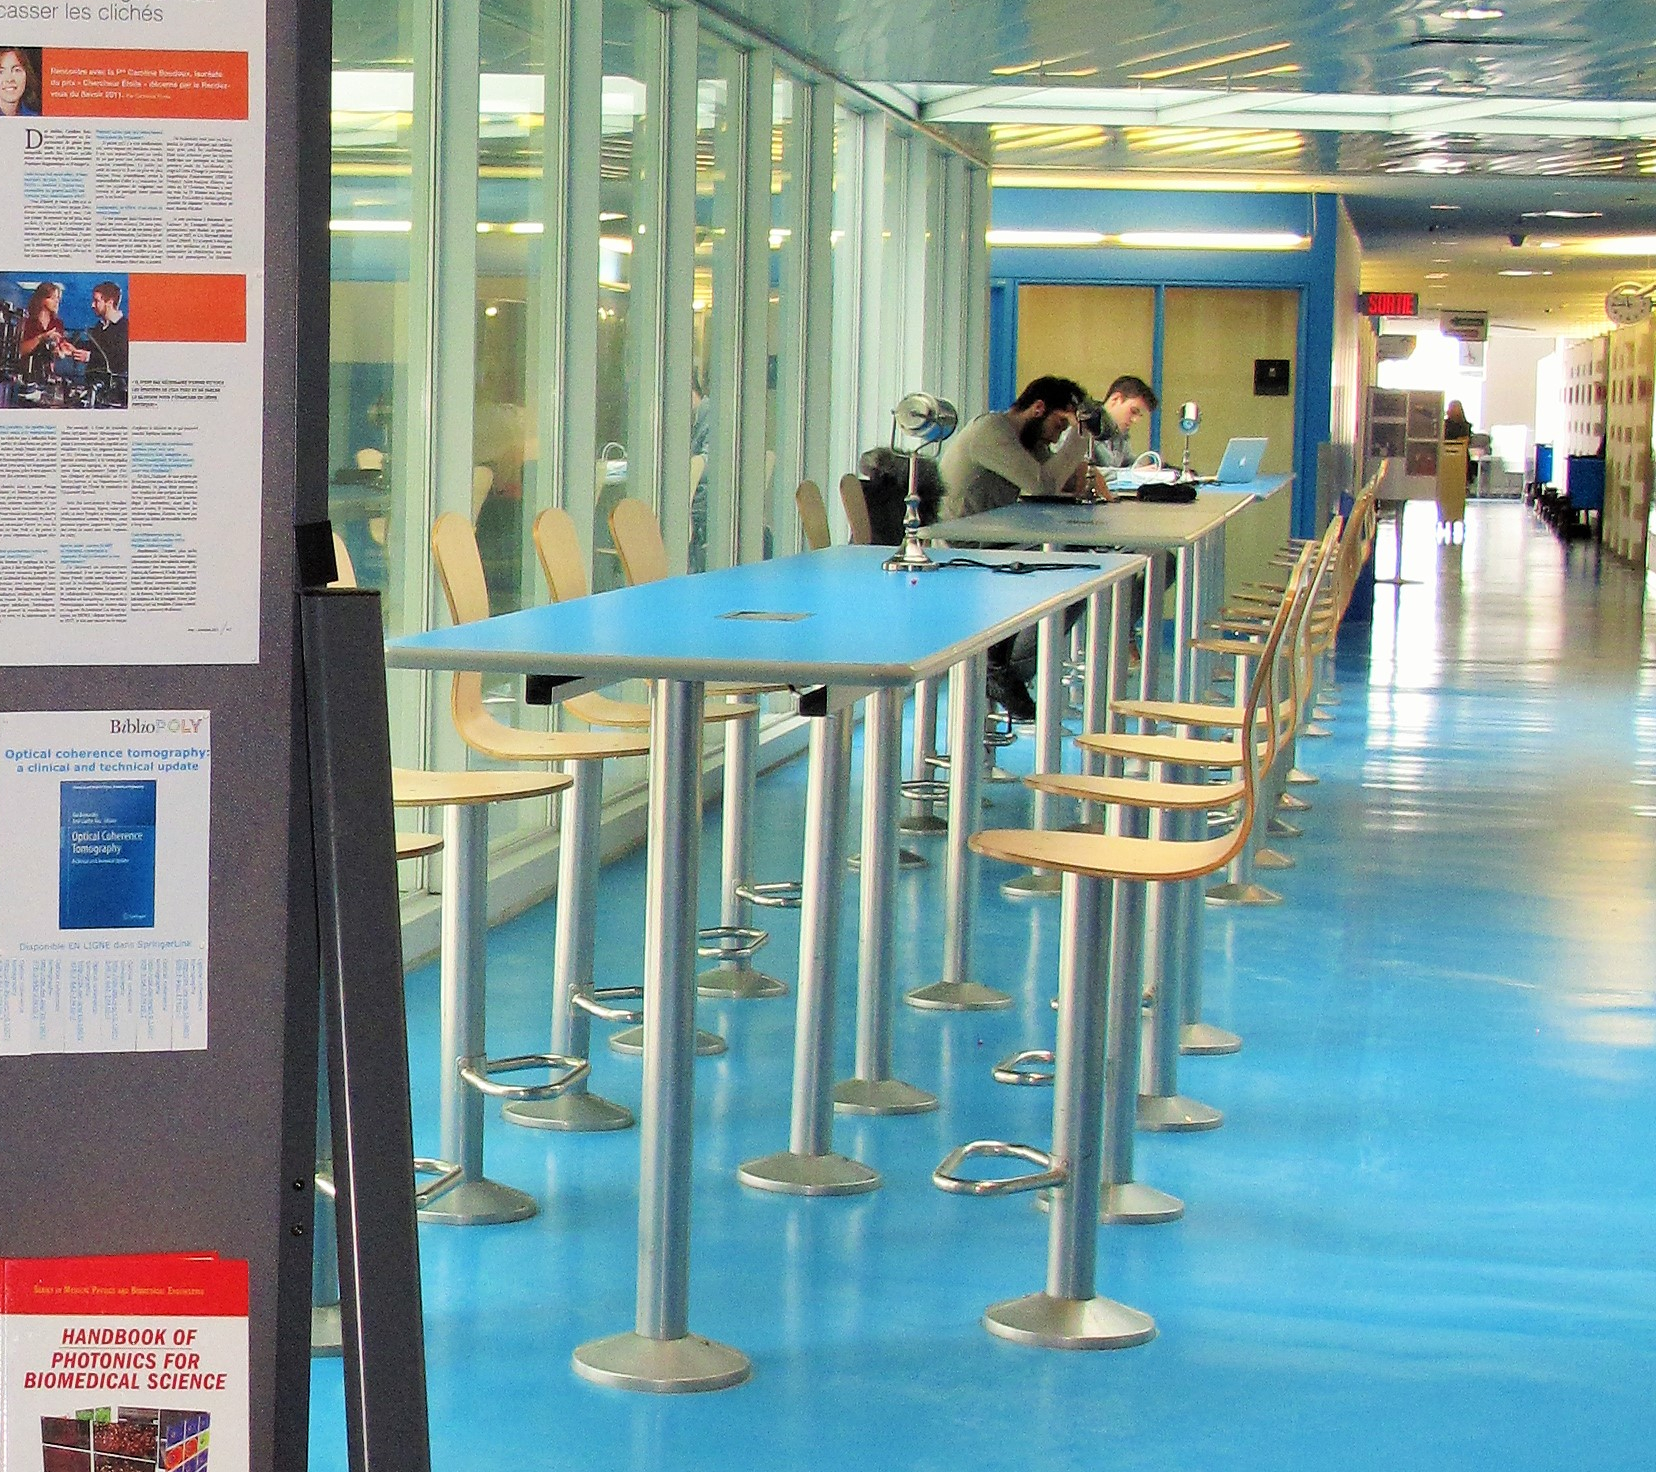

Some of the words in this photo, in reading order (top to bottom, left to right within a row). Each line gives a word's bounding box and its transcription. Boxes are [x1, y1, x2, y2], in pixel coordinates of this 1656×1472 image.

[66, 3, 91, 19] les
[98, 5, 163, 22] clichés
[1369, 294, 1413, 314] SORTIE
[5, 749, 51, 761] Optical
[55, 749, 123, 759] coherence
[127, 747, 210, 760] tomography:
[17, 764, 24, 772] a
[28, 762, 69, 772] clinical
[74, 762, 95, 772] and
[100, 762, 153, 771] technical
[158, 762, 199, 773] update
[72, 831, 100, 843] Optical
[72, 843, 122, 854] Tomography
[62, 1328, 166, 1346] HANDBOOK
[173, 1328, 197, 1346] OF
[51, 1352, 156, 1370] PHOTONICS
[164, 1352, 200, 1370] FOR
[24, 1372, 140, 1390] BIOMEDICAL
[147, 1372, 227, 1390] SCIENCE
